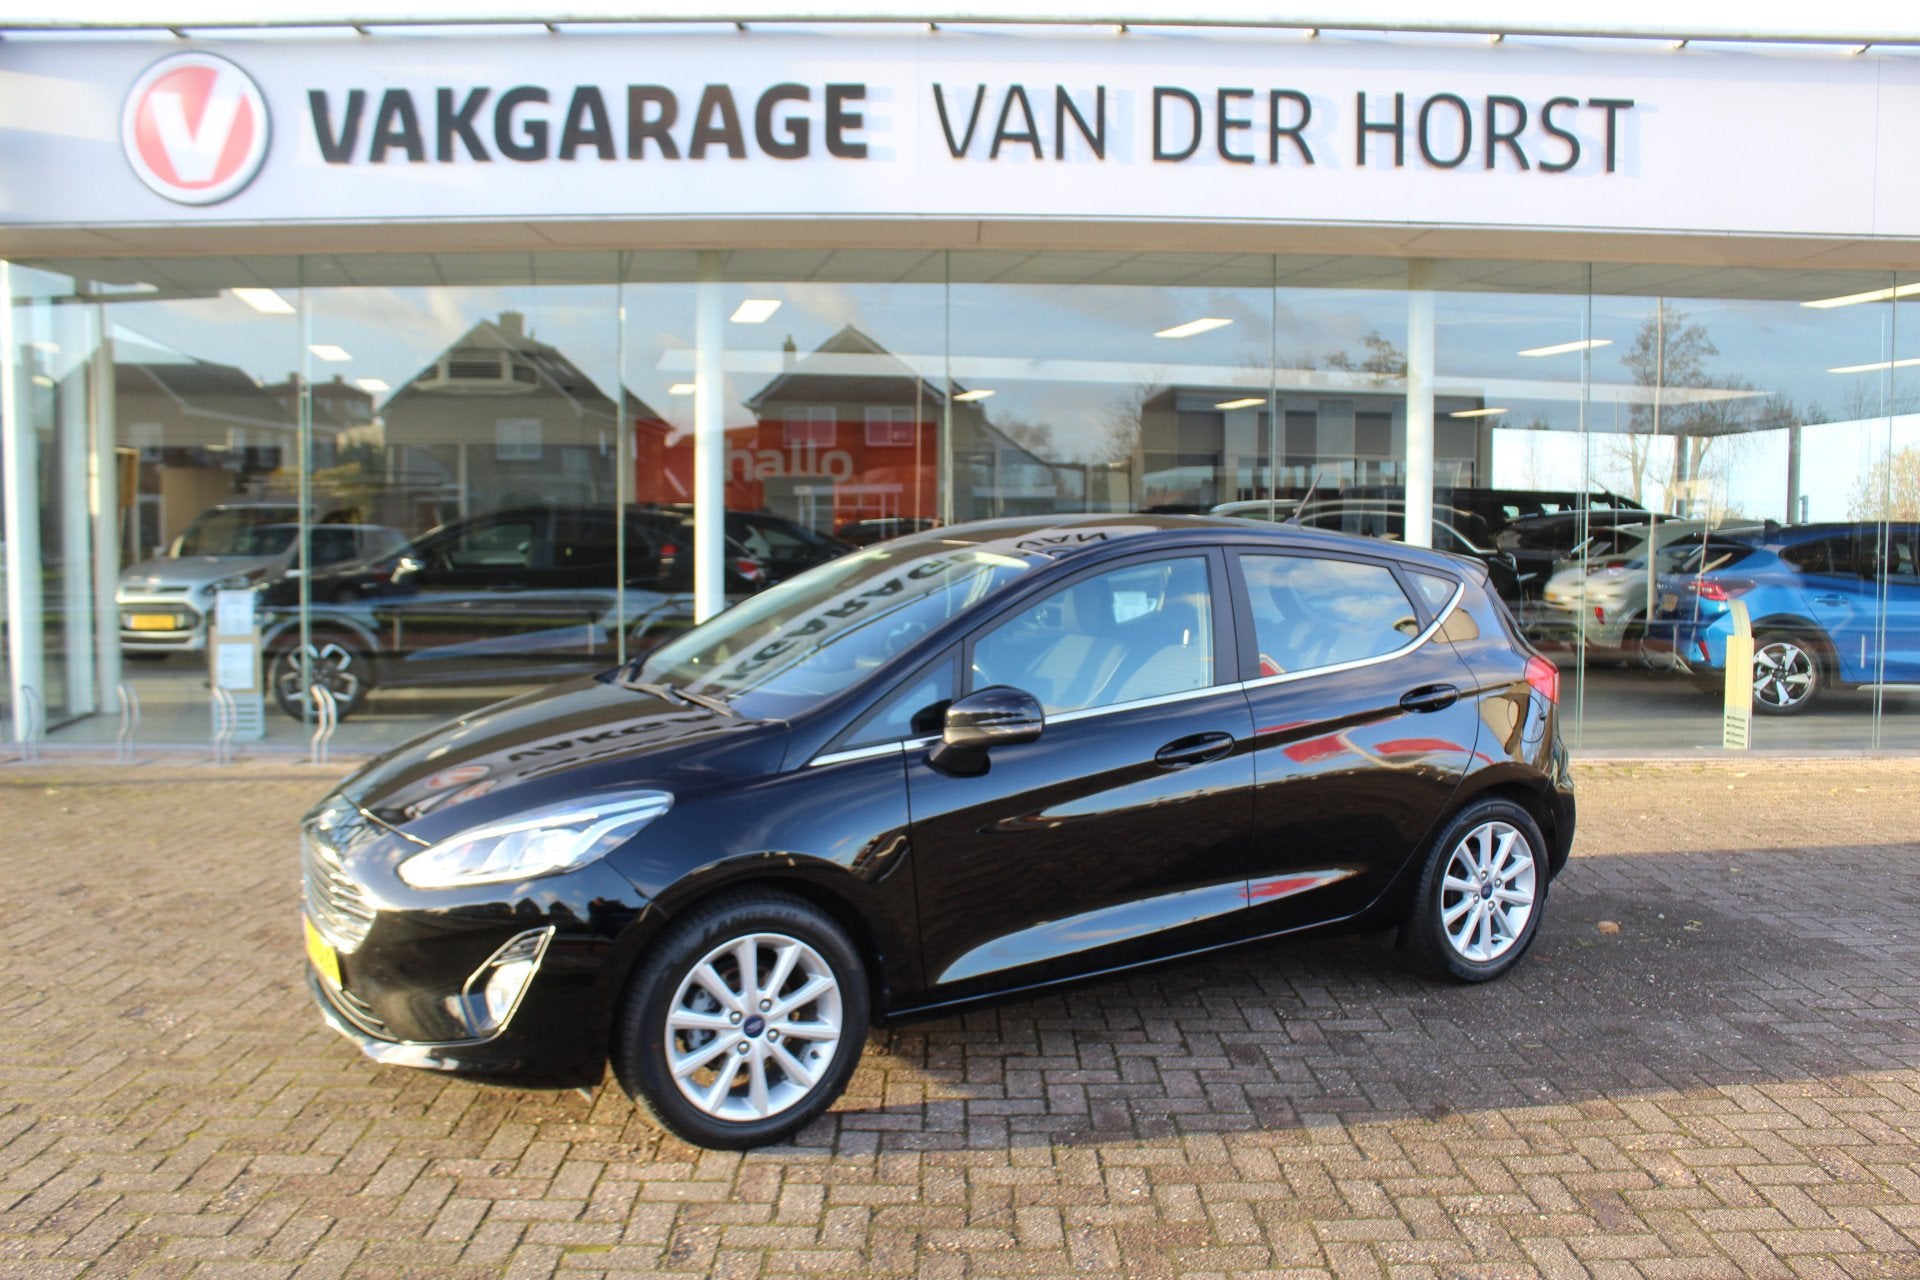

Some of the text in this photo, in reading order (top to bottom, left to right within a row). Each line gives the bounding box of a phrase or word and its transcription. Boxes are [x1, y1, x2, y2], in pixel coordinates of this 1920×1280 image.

[308, 82, 1635, 174] VAKGARAGE VAN DER HORST
[724, 438, 854, 483] hallo
